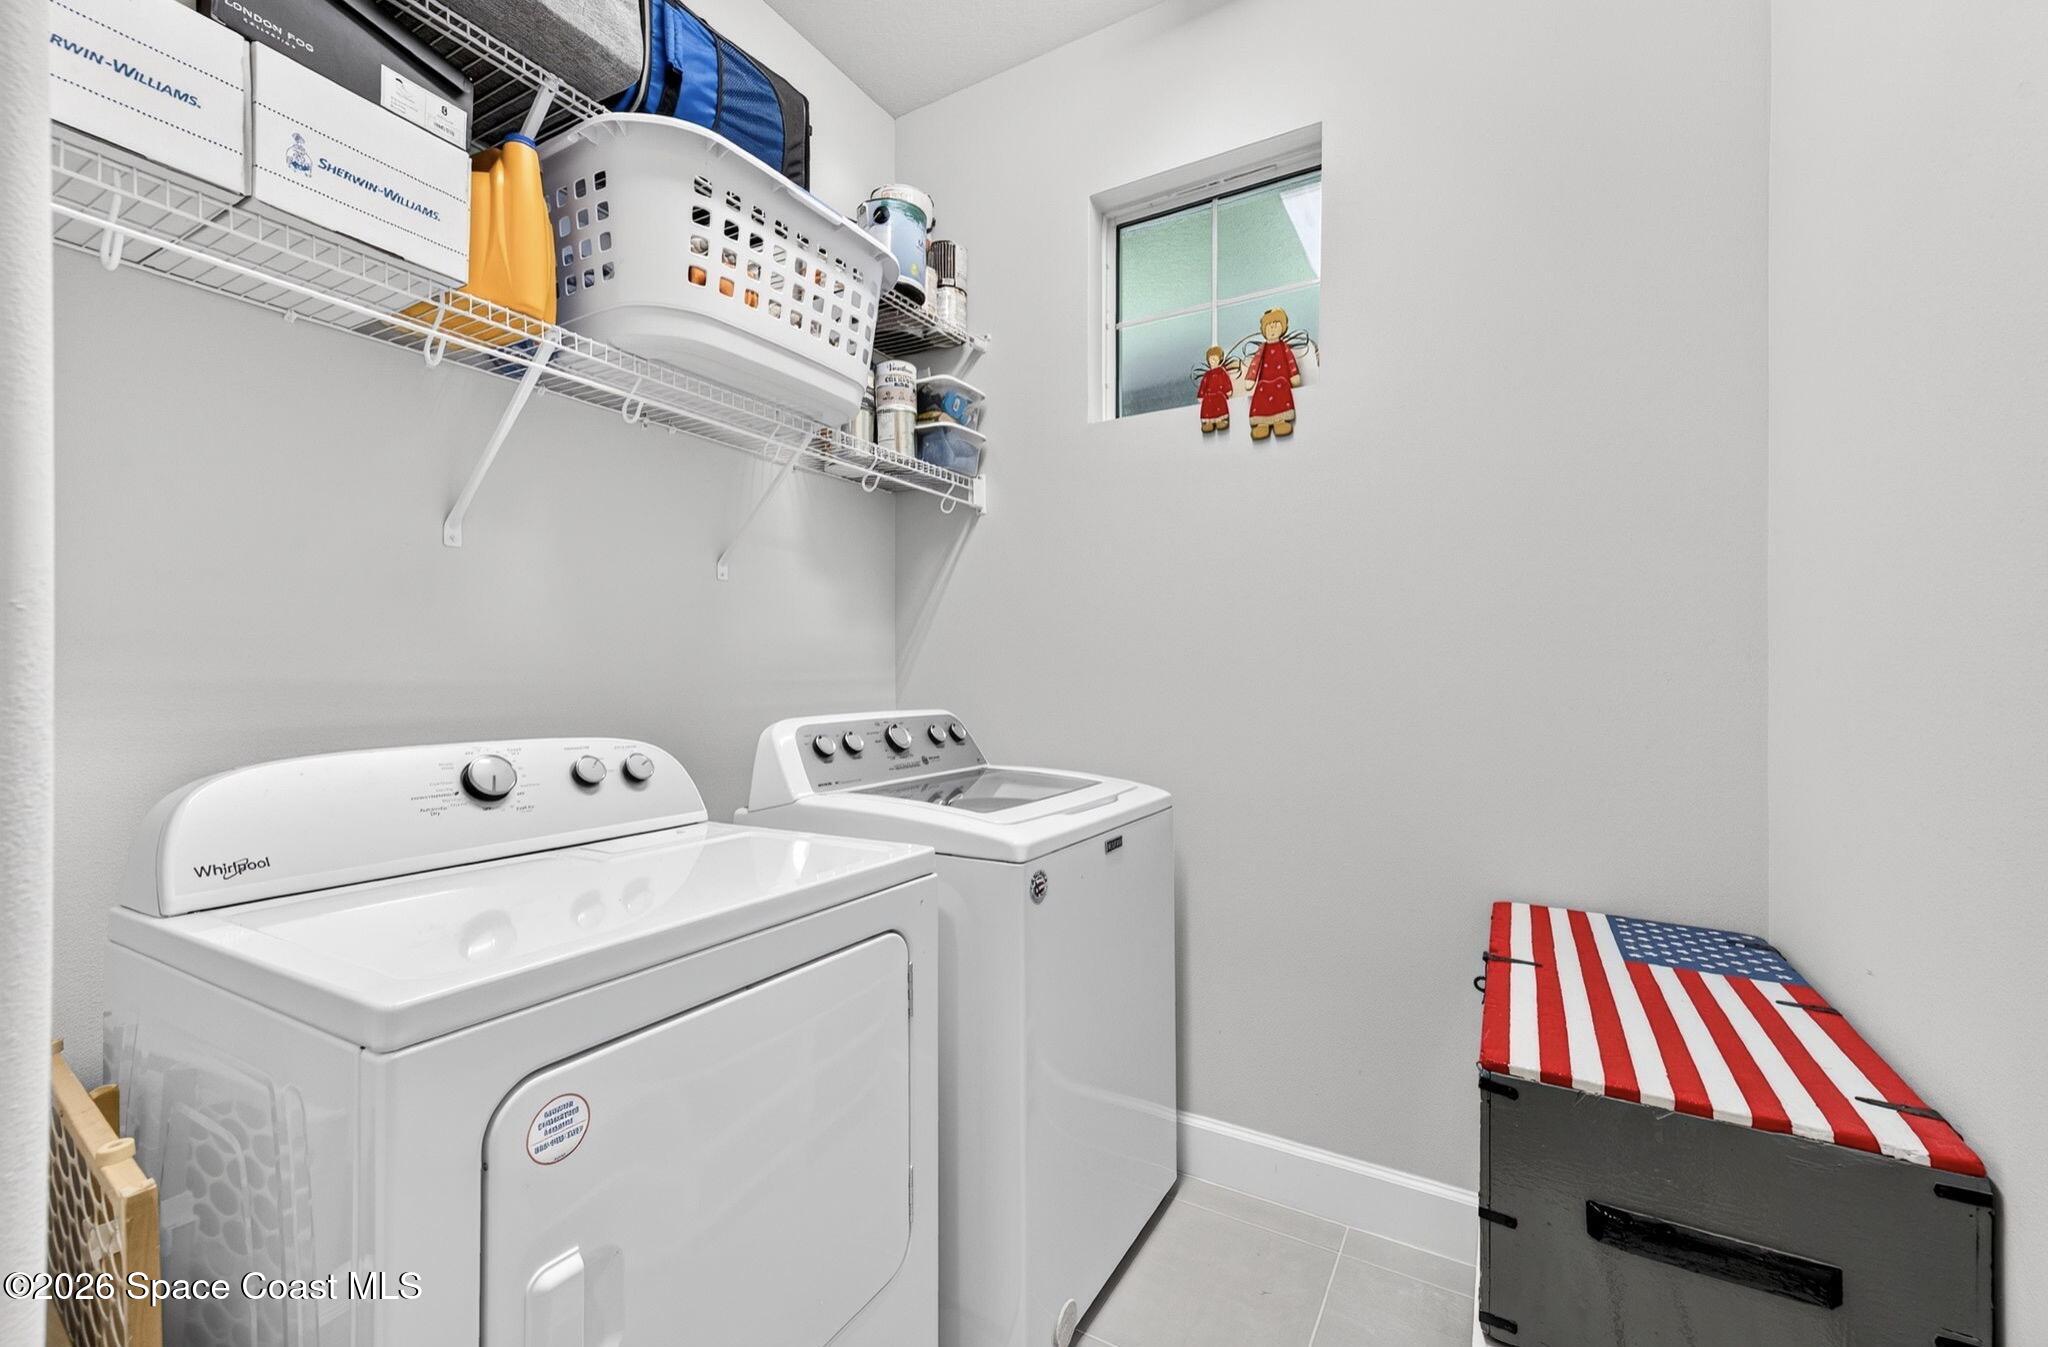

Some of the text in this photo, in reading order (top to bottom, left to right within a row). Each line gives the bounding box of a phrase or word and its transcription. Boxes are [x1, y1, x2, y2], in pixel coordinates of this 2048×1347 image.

[224, 0, 314, 53] LONDON FOG
[193, 856, 271, 880] Whirlpool
